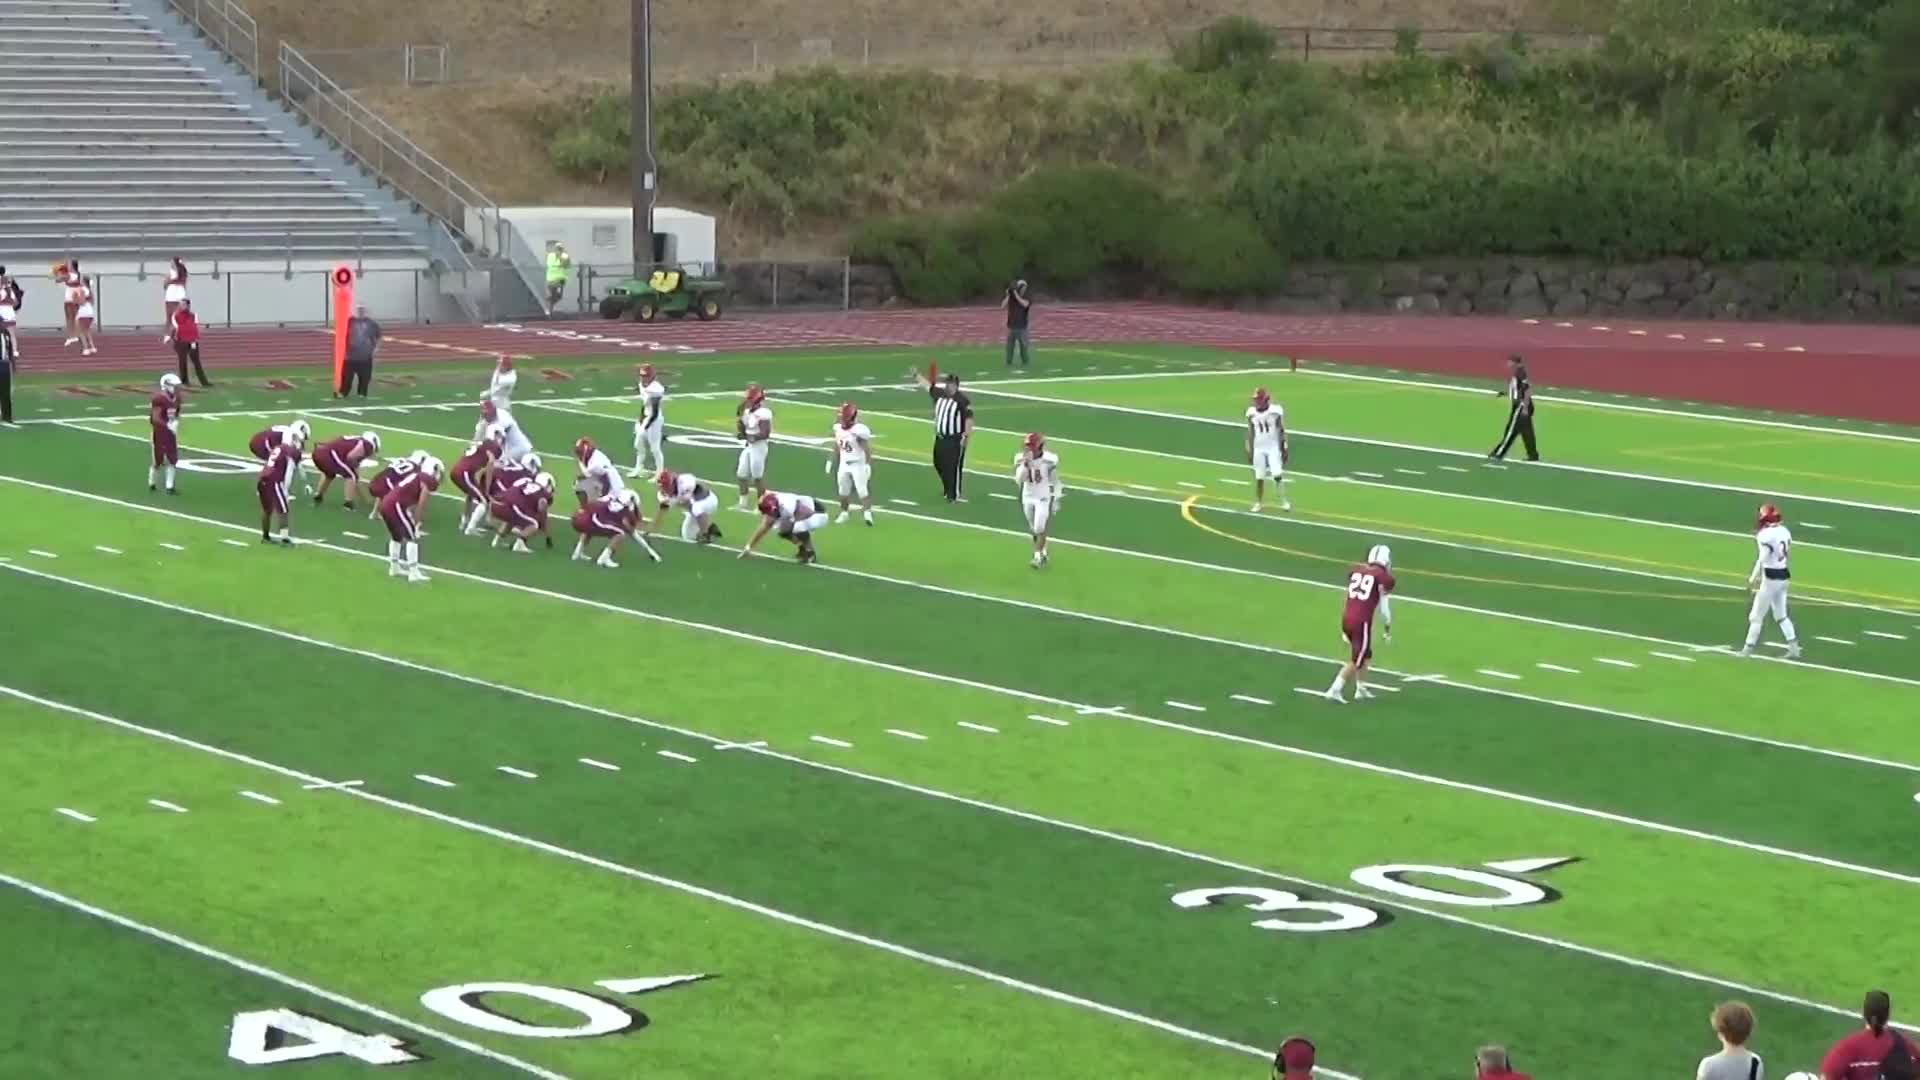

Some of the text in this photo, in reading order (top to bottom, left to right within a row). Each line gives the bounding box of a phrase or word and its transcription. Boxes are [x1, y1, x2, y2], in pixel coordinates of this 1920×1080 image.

[1348, 572, 1375, 600] 29
[1171, 864, 1550, 932] 30
[228, 981, 636, 1065] 40
